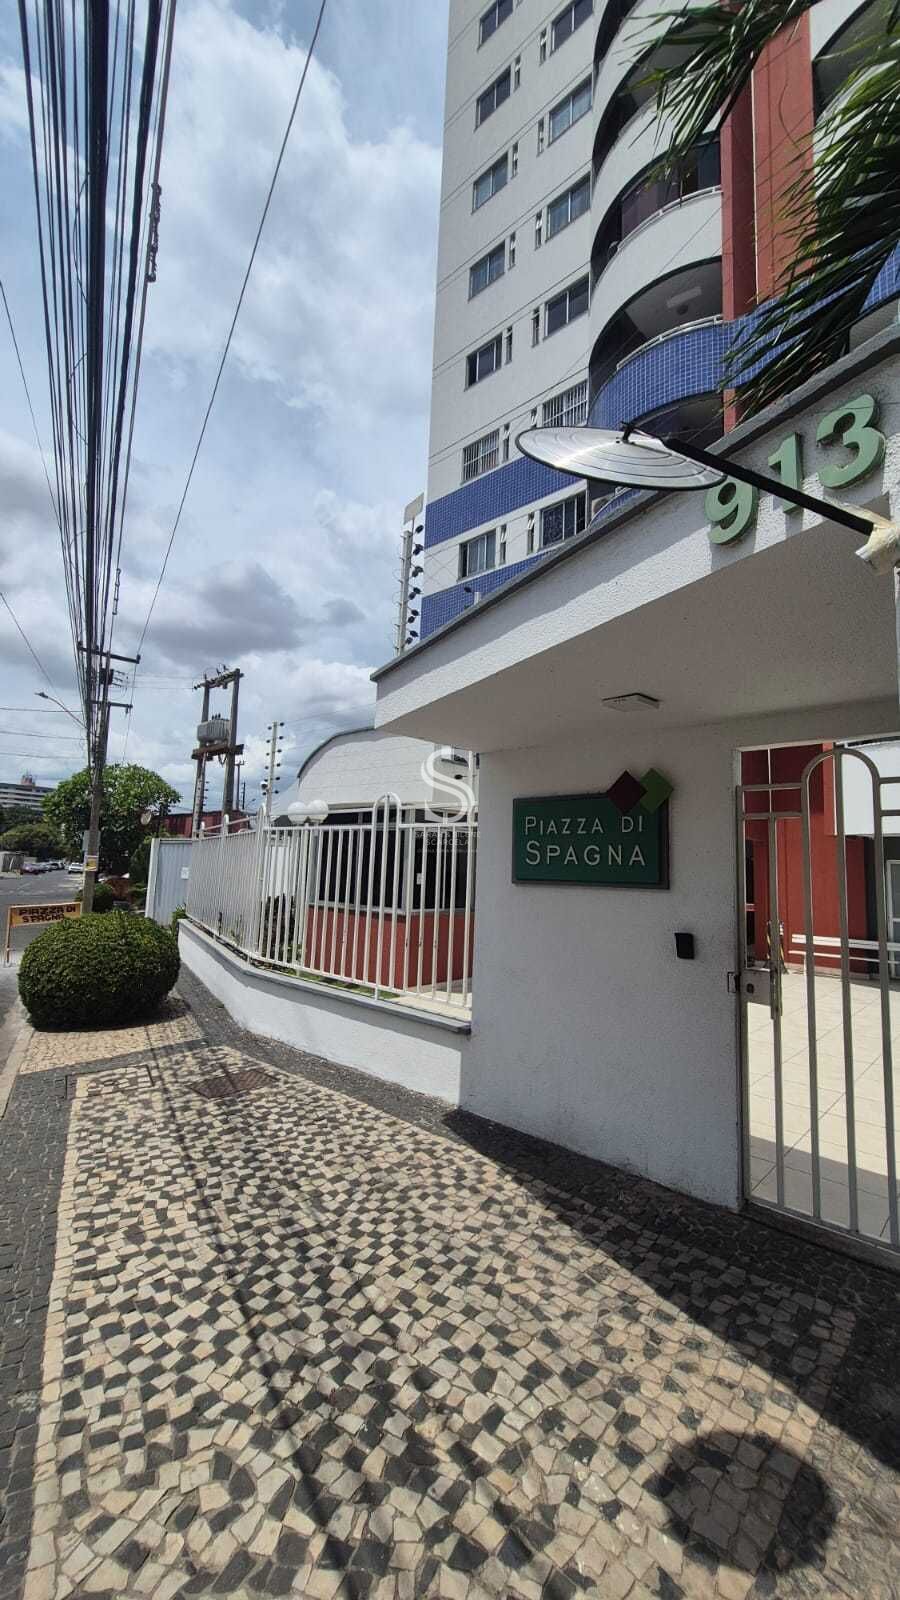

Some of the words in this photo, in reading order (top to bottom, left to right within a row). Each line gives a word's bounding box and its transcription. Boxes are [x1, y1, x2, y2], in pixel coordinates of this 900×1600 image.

[704, 394, 886, 545] 913
[525, 816, 604, 836] PIAZZA
[621, 816, 643, 833] DI
[526, 840, 646, 866] SPAGNA
